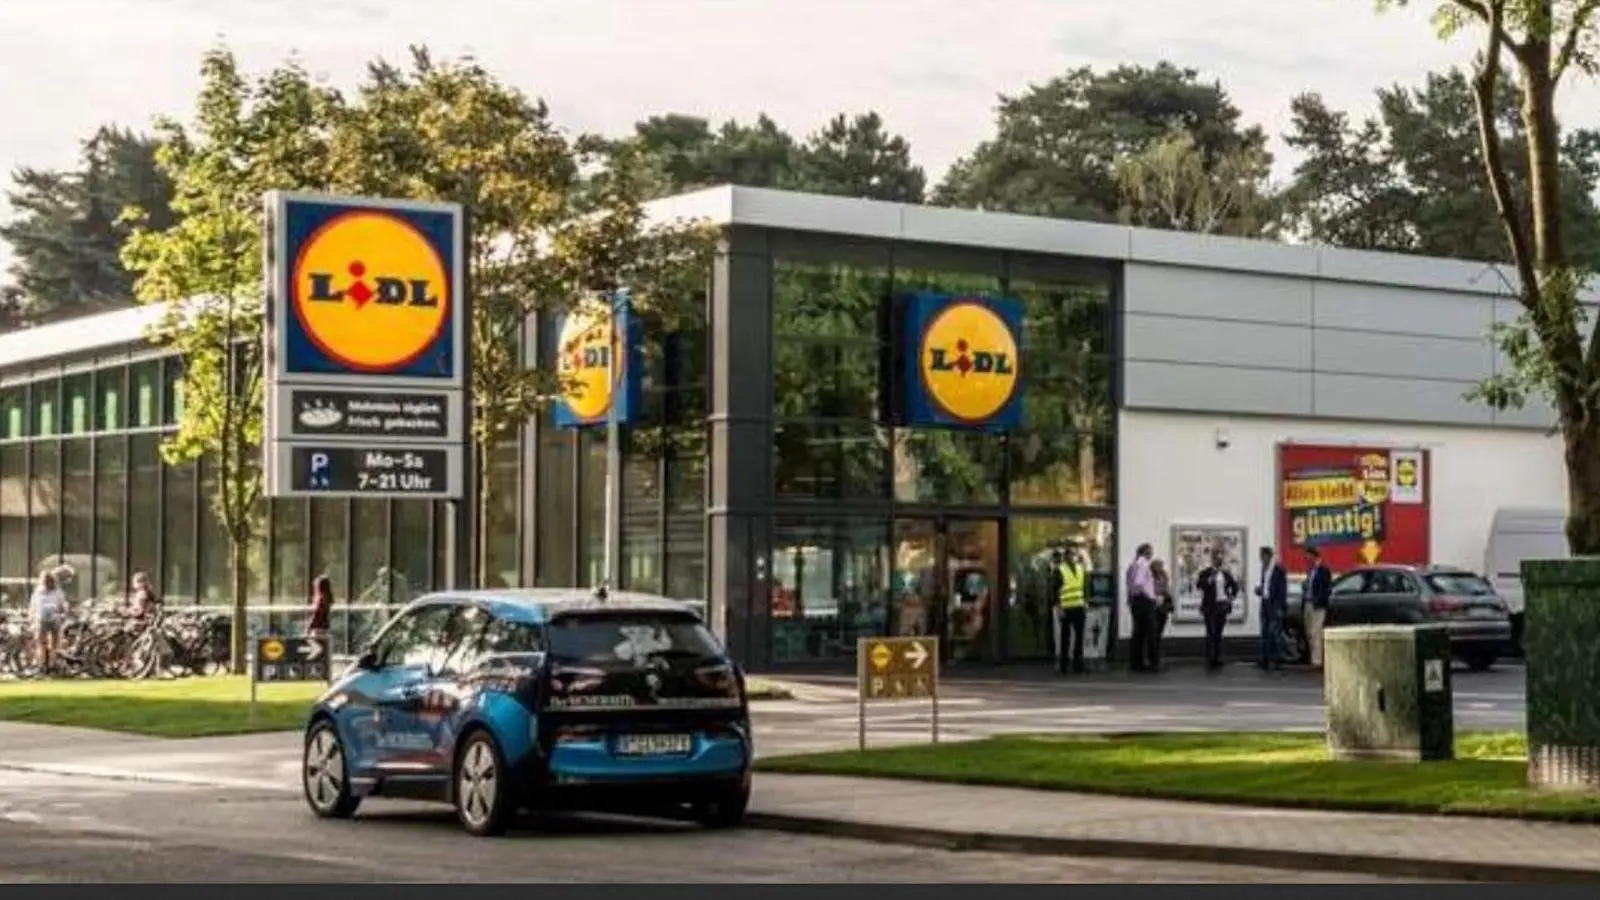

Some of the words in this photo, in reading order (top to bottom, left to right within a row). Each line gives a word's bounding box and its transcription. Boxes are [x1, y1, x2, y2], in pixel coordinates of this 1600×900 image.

[311, 453, 328, 472] P
[400, 474, 433, 490] Uhr
[1293, 504, 1382, 546] günstig!
